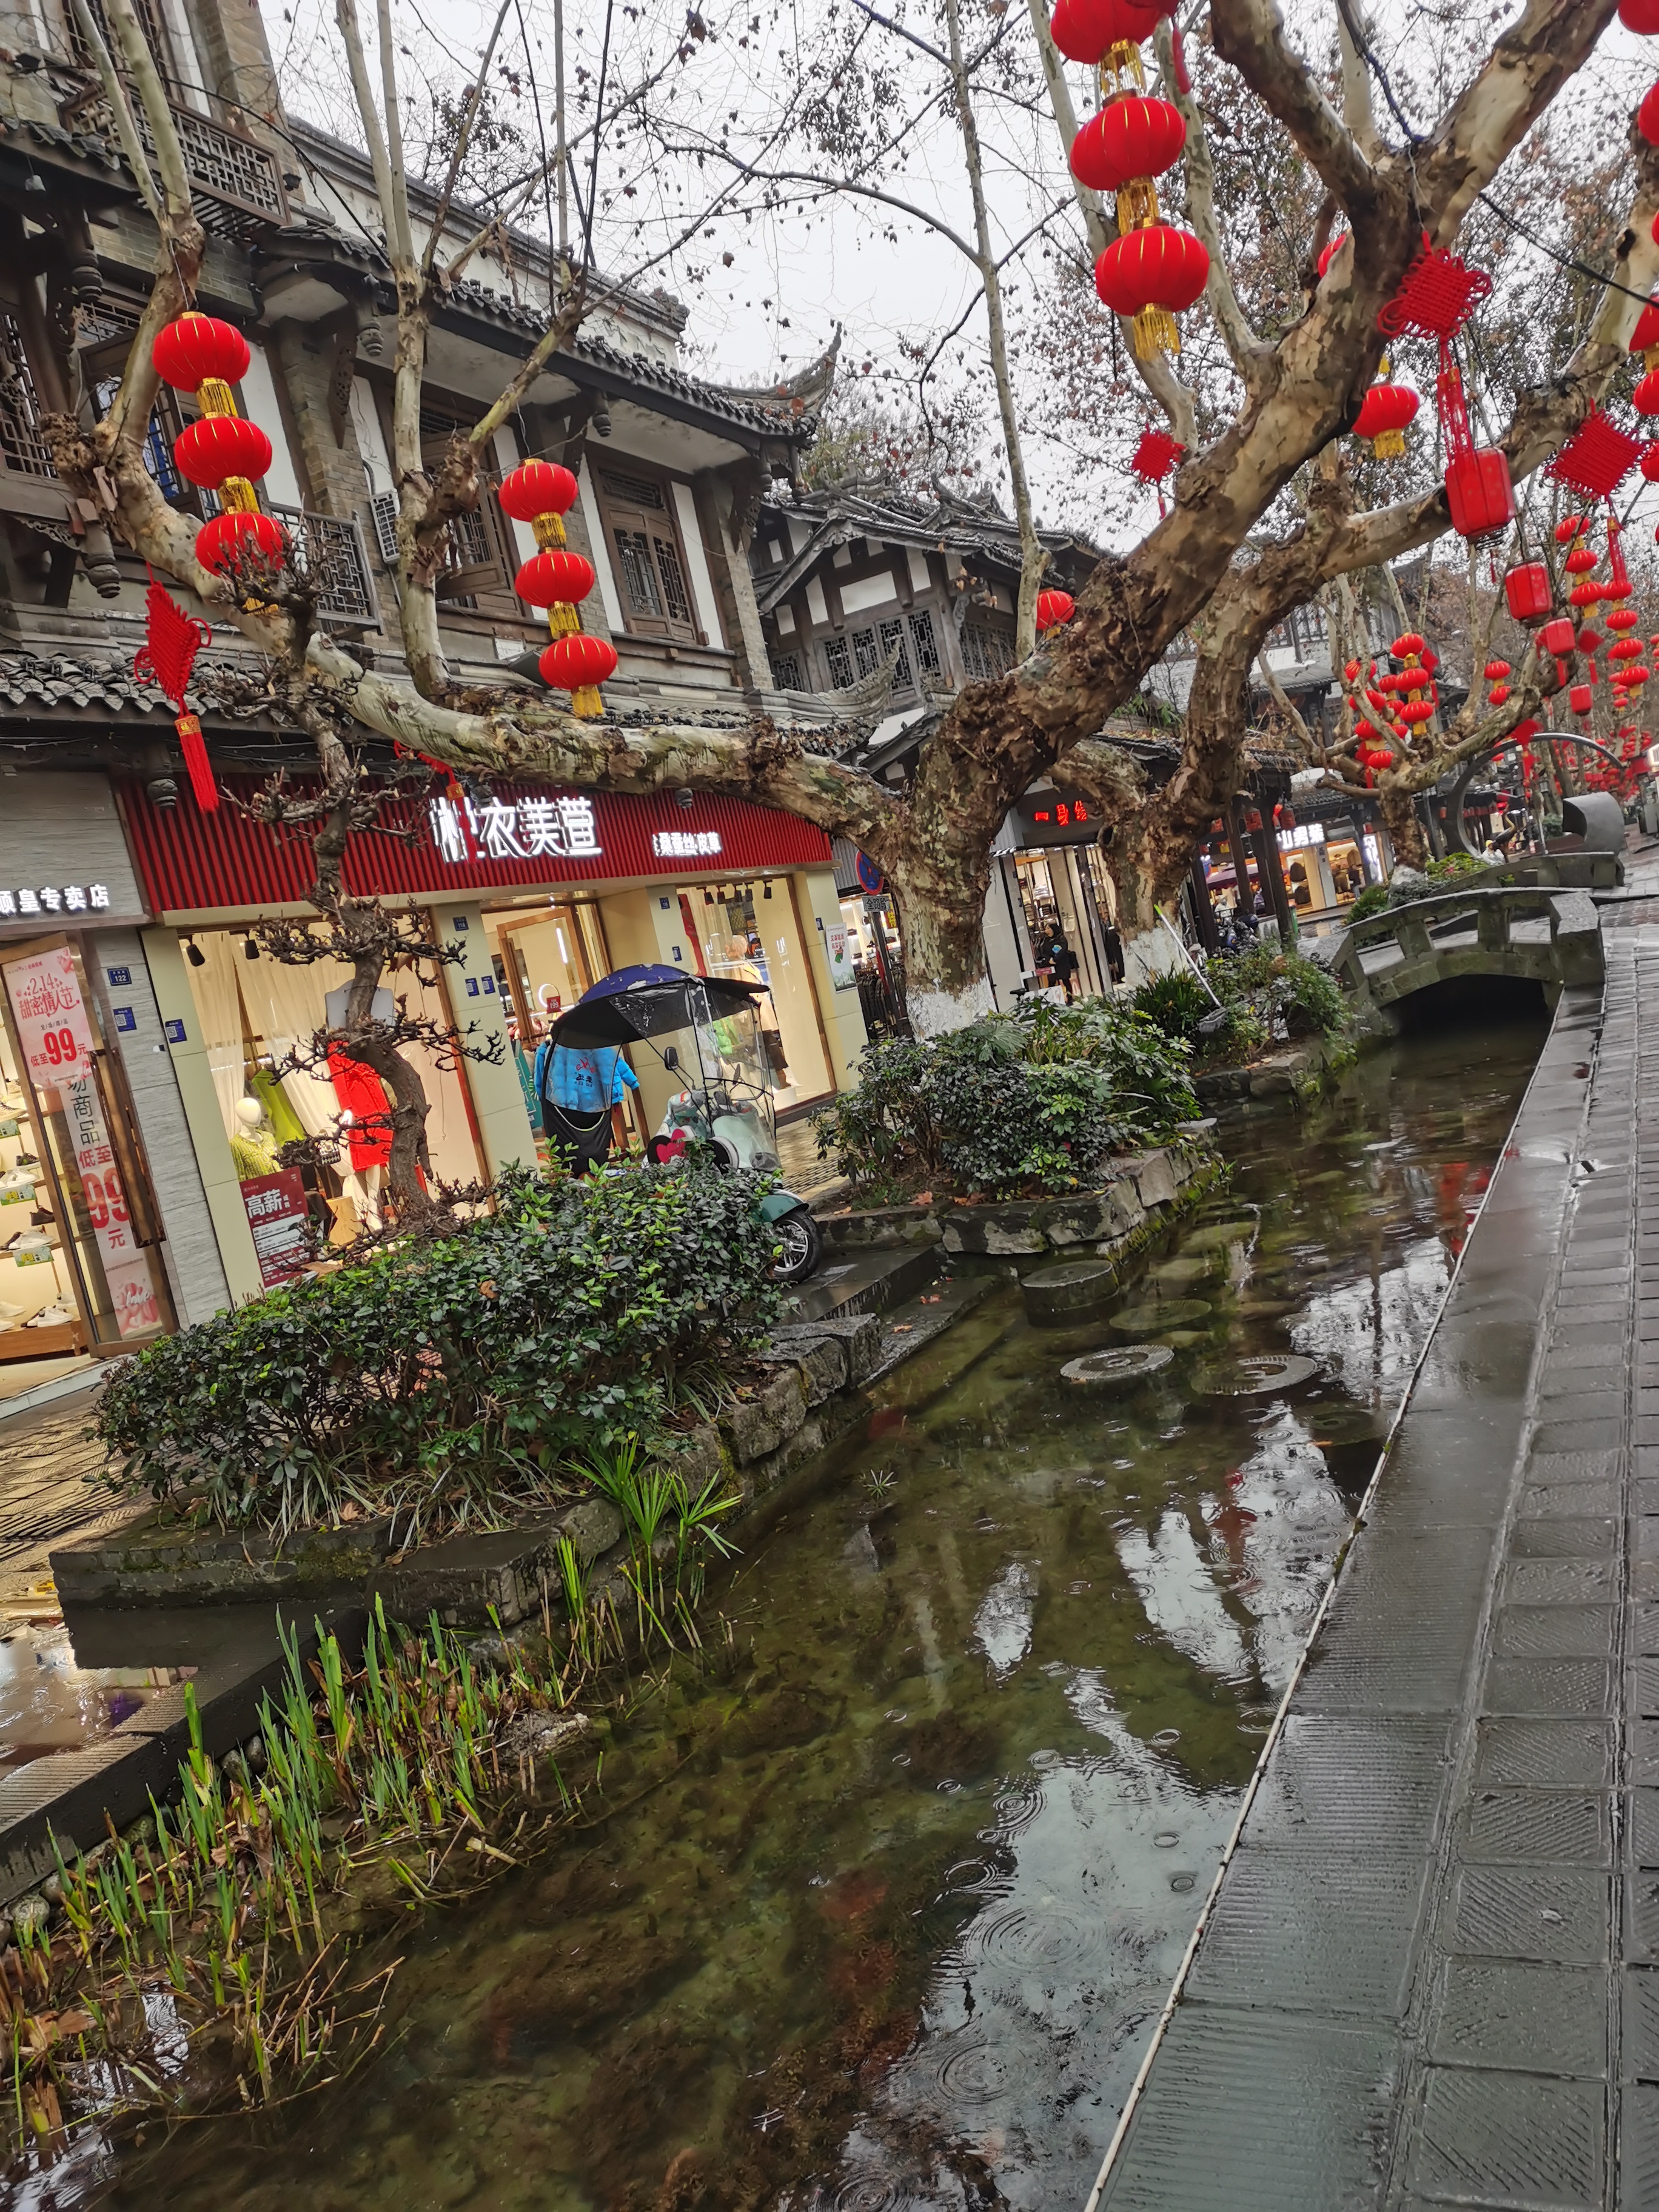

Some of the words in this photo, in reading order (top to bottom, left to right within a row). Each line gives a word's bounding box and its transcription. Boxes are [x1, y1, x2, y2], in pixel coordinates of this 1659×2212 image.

[78, 1144, 113, 1169] 低至
[81, 1167, 130, 1229] 99
[245, 1188, 283, 1219] 高薪
[108, 1228, 126, 1250] 元
